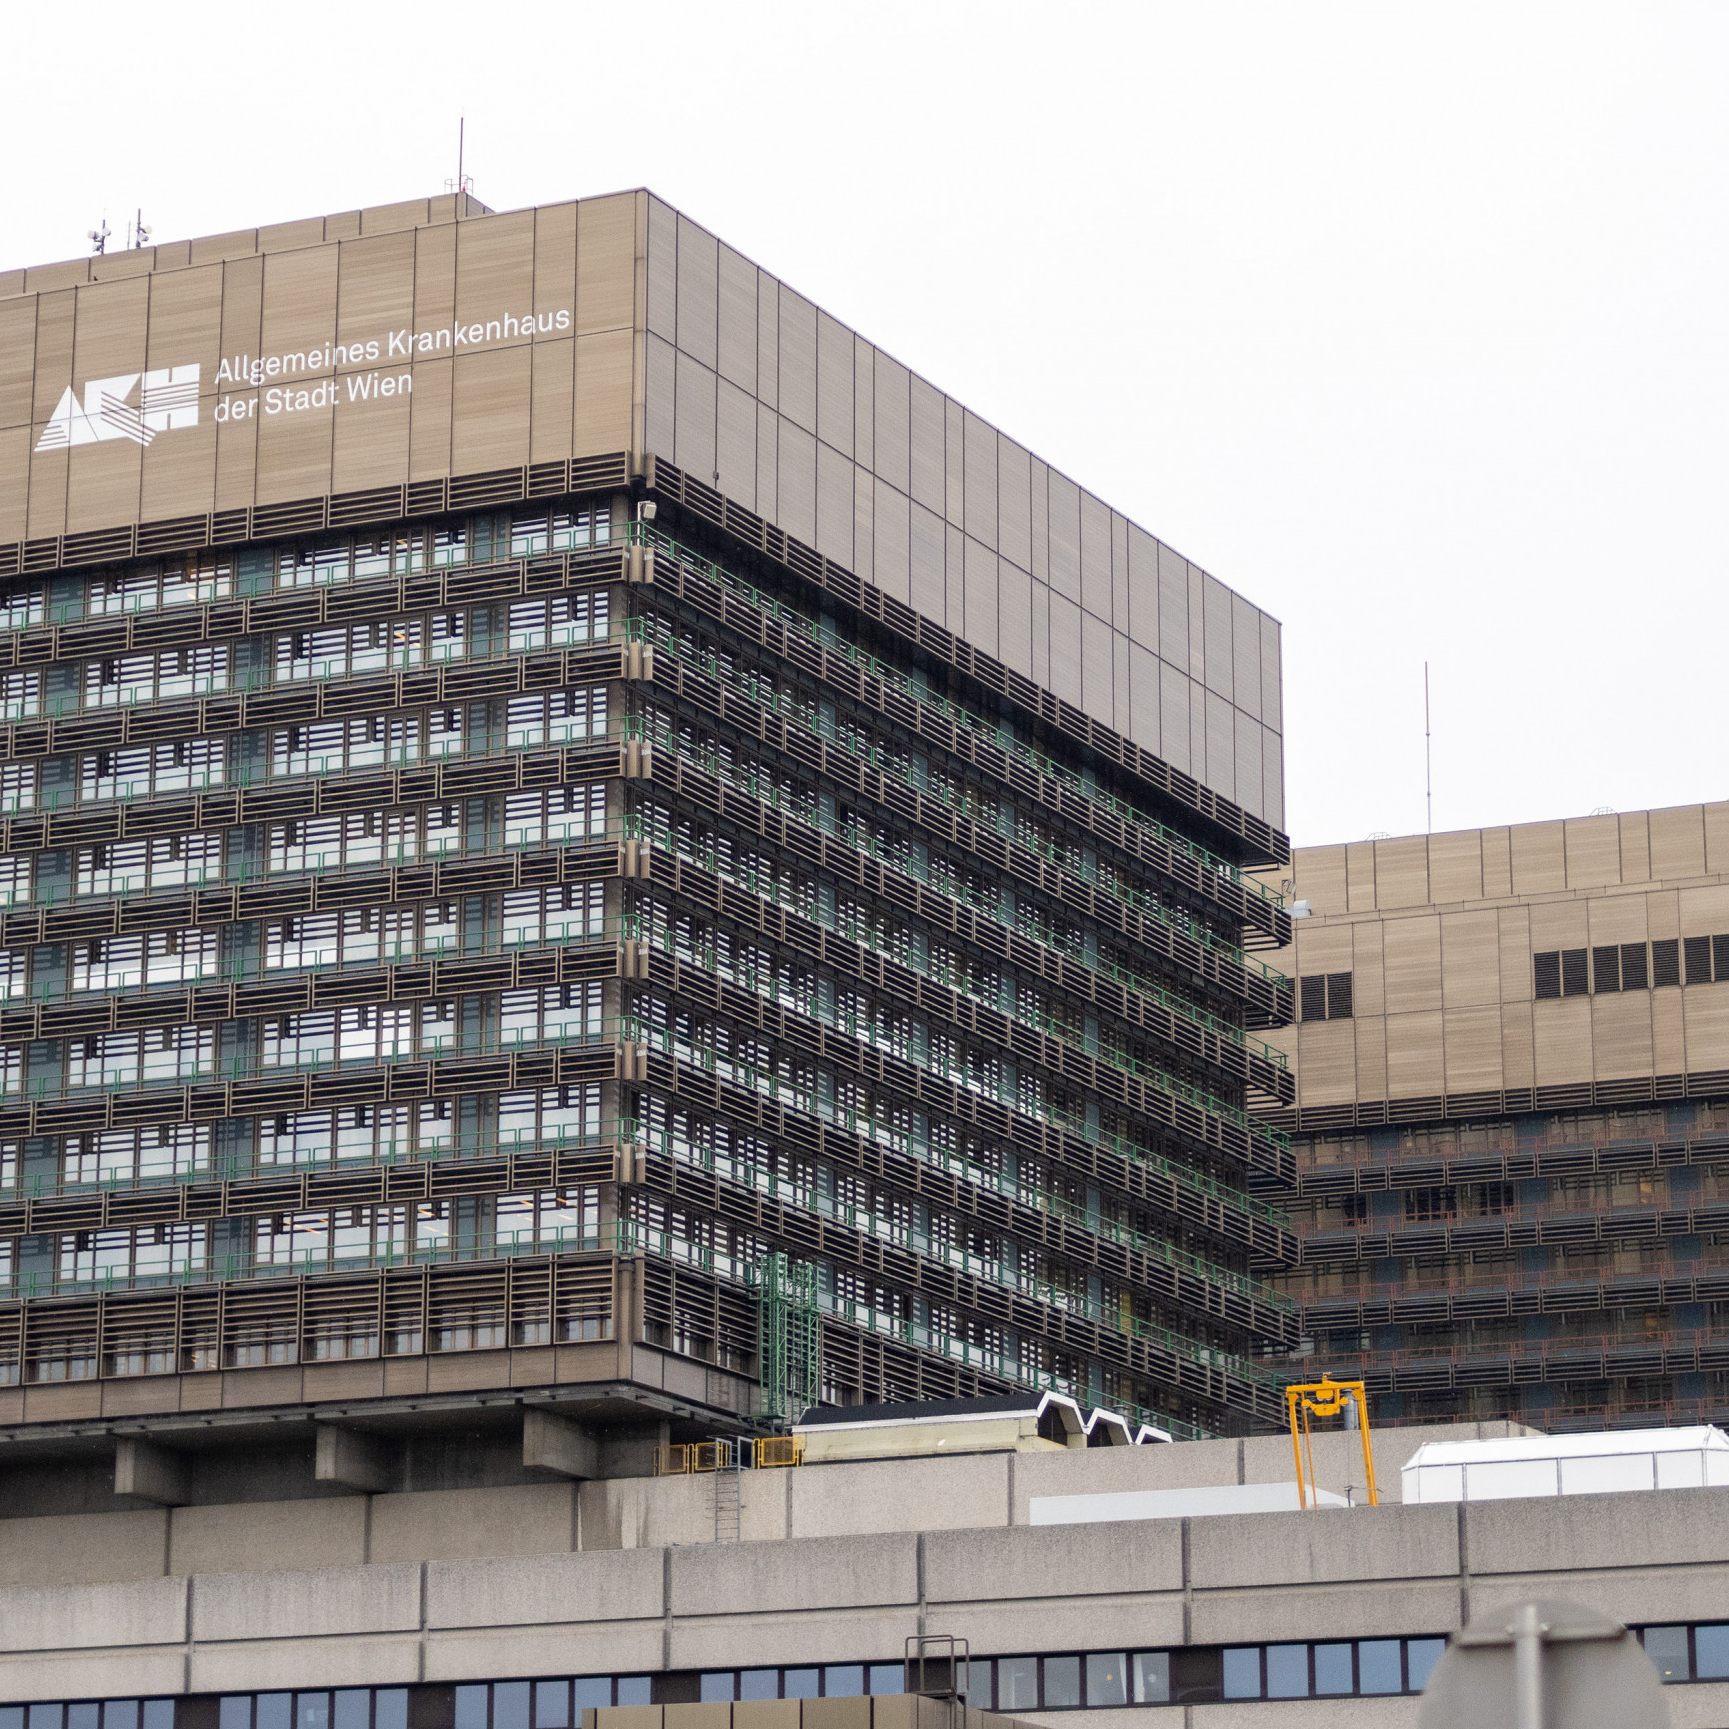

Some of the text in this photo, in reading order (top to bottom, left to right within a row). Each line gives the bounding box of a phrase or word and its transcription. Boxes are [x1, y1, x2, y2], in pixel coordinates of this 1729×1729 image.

[214, 309, 571, 389] Allgemeines Krankenhaus
[214, 372, 413, 422] der Stadt Wien
